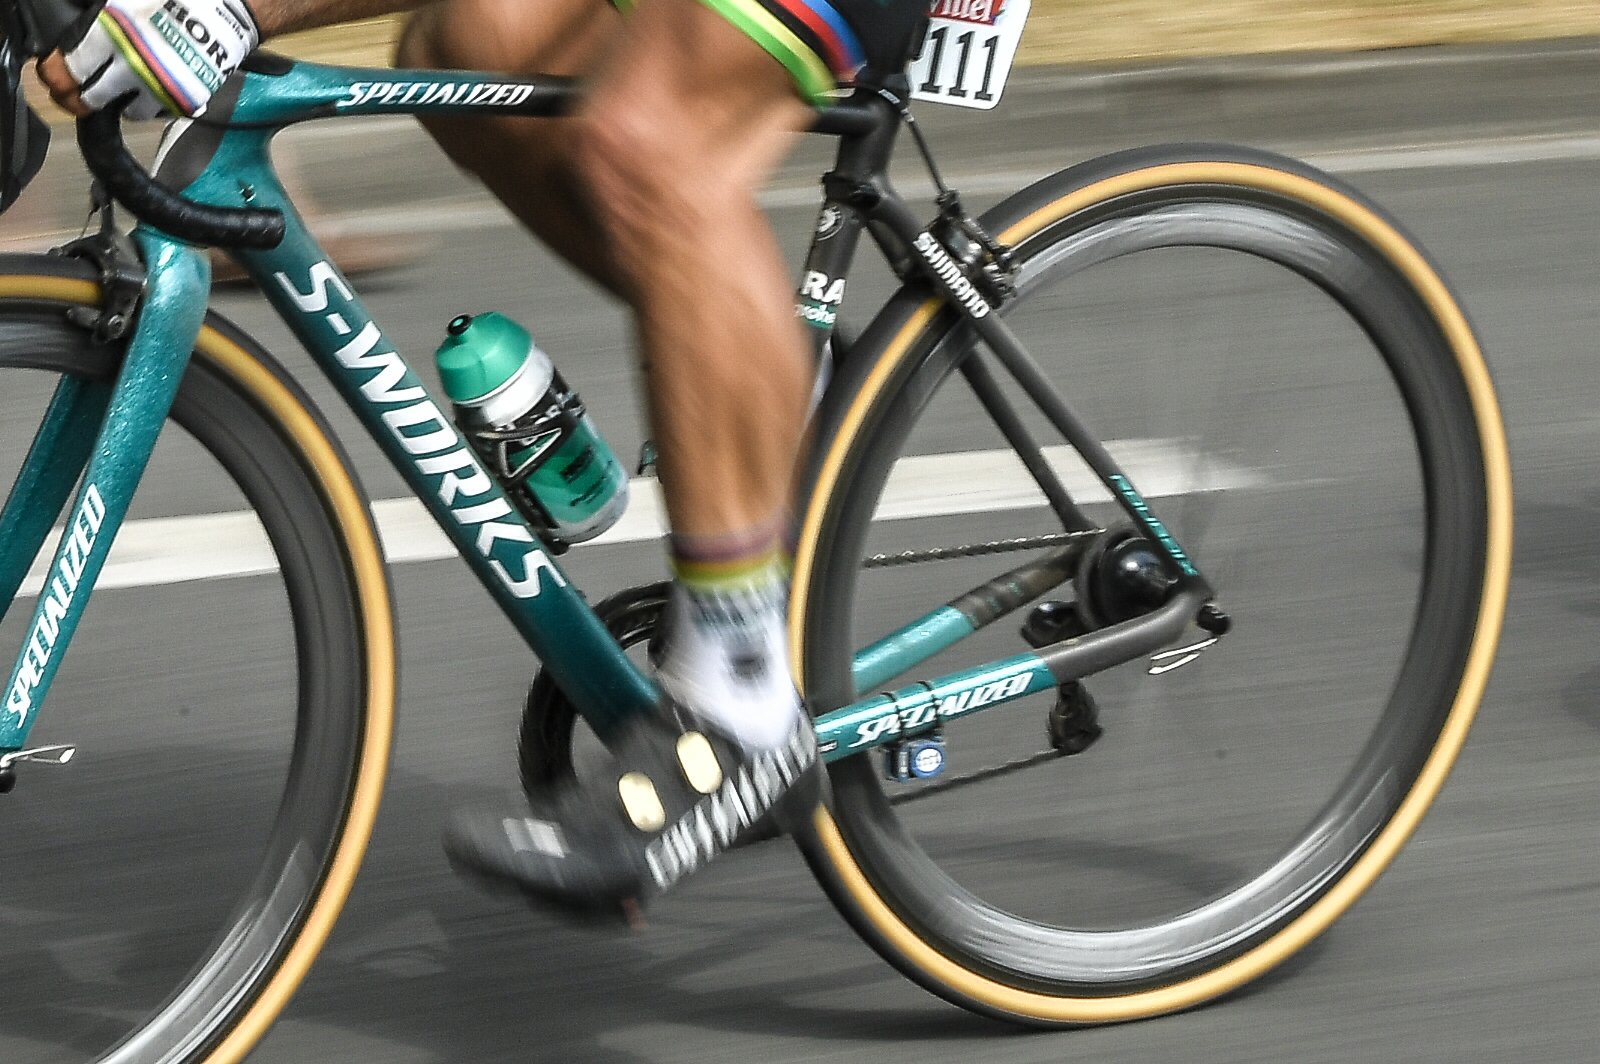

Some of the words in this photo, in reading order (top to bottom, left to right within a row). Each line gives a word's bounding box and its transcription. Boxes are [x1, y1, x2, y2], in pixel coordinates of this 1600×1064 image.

[336, 81, 536, 107] SPECIALIZED
[920, 25, 1001, 102] 111
[800, 269, 847, 305] RA
[911, 231, 991, 320] SHIMANO
[273, 259, 567, 600] S-WORKS
[6, 482, 108, 730] SPECIALIZED
